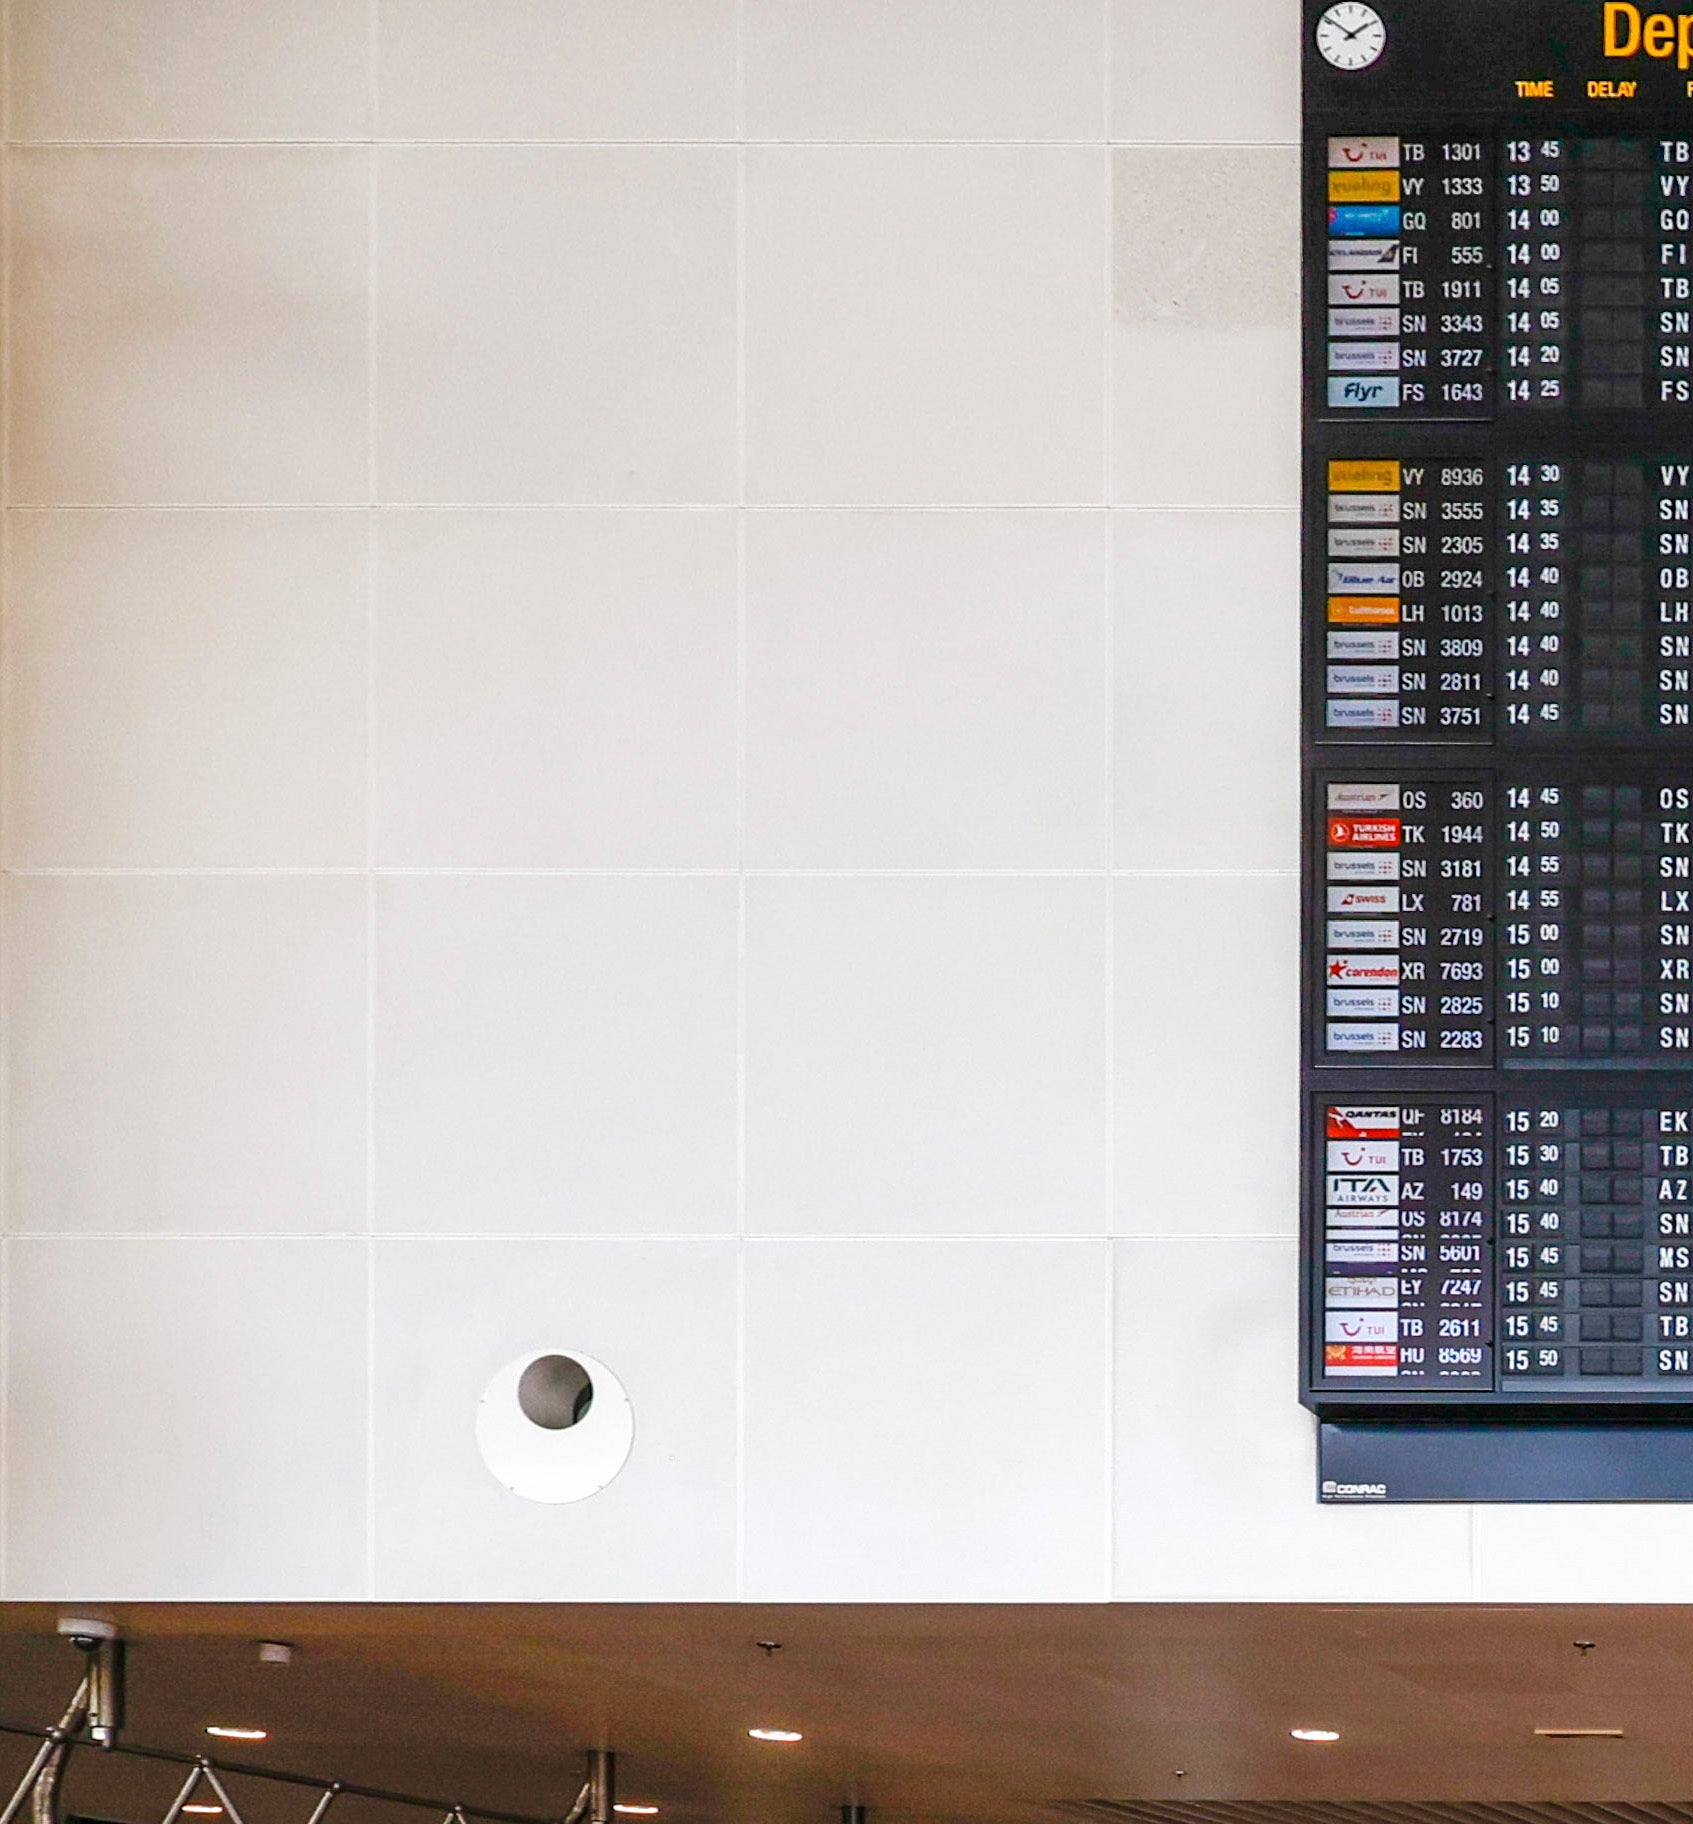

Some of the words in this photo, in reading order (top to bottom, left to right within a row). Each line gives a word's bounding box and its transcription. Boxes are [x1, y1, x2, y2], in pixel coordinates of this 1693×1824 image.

[1515, 81, 1554, 97] TIME
[1588, 81, 1636, 97] DELAY
[1660, 140, 1690, 163] TB
[1661, 243, 1687, 265] FI
[1344, 382, 1383, 400] Flyr
[1660, 465, 1690, 486] VY
[1660, 822, 1690, 844] TK
[1660, 992, 1689, 1014] SN
[1659, 1145, 1689, 1167] TB
